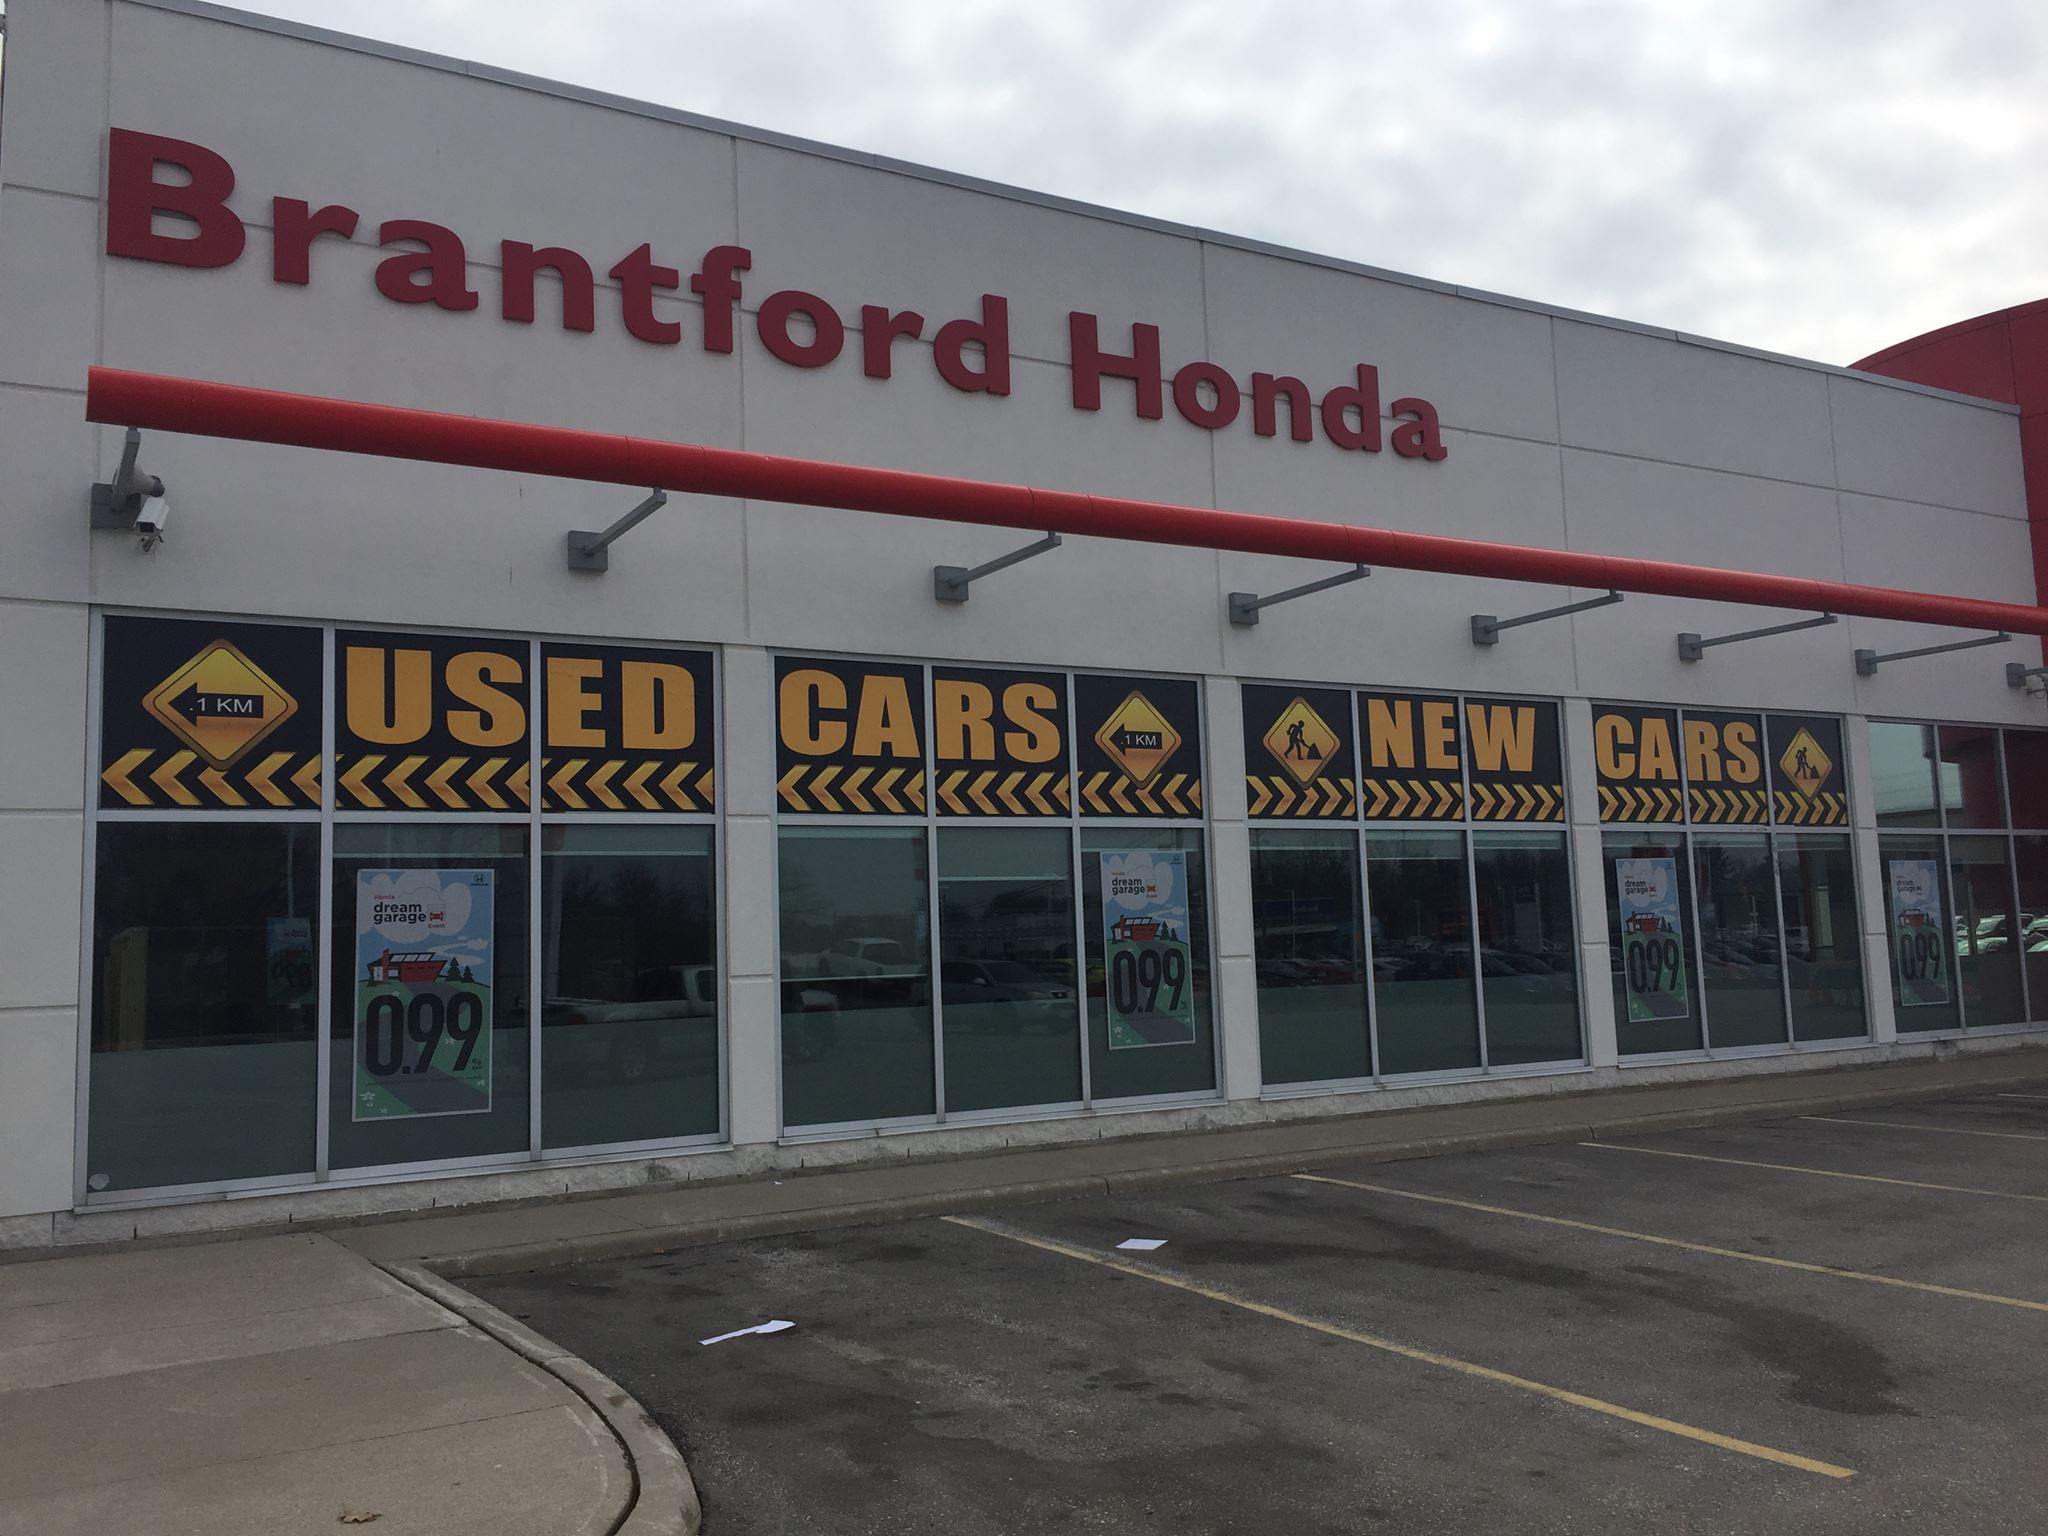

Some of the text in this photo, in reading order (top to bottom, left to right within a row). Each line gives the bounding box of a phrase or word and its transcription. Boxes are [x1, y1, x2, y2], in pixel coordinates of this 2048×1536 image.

[106, 126, 1449, 463] Brantford Honda
[217, 698, 253, 713] KM
[345, 645, 1061, 764] USED CARS
[1135, 734, 1157, 746] KM
[1367, 698, 1761, 785] NEW CARS
[1111, 877, 1143, 886] dream
[1112, 886, 1146, 896] garage
[373, 902, 422, 913] dream
[373, 912, 427, 925] garage
[1113, 948, 1186, 1014] 0.99
[1629, 939, 1679, 994] 0.99
[1901, 932, 1941, 981] 0.99
[365, 992, 483, 1076] 0.99
